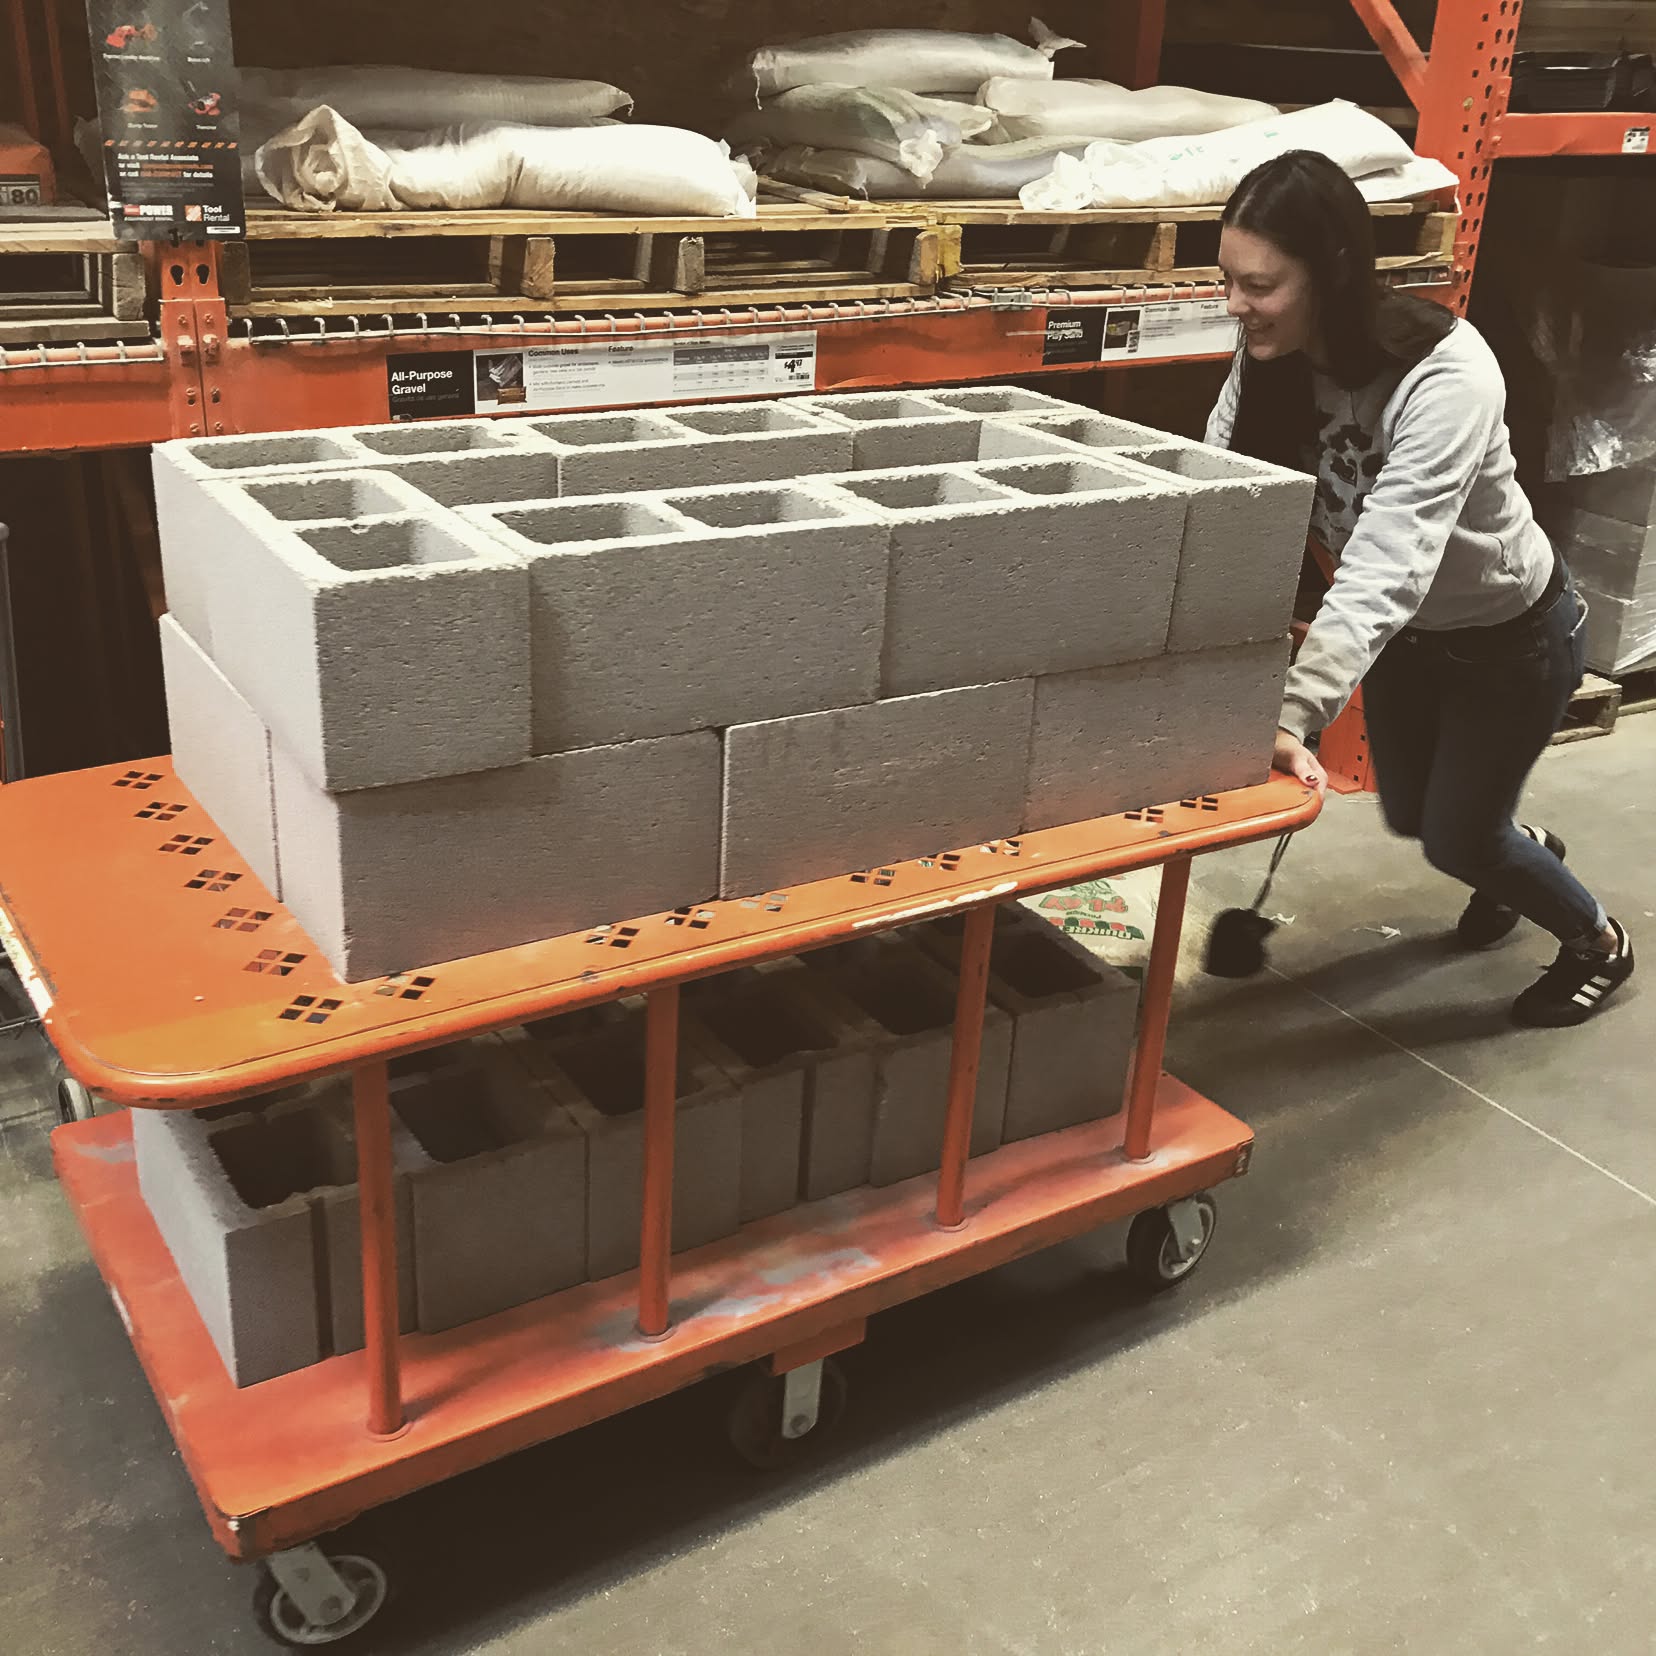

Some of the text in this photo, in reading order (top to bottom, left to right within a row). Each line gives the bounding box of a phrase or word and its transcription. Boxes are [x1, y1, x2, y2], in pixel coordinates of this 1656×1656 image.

[139, 204, 173, 216] POWER
[202, 205, 222, 213] Tool
[203, 213, 230, 222] Rental
[1047, 319, 1082, 330] Premium
[527, 347, 579, 358] Common Uses
[608, 345, 634, 353] Feature
[391, 370, 453, 382] All-Purpose
[391, 383, 426, 395] Gravel
[1038, 895, 1129, 913] PLAY
